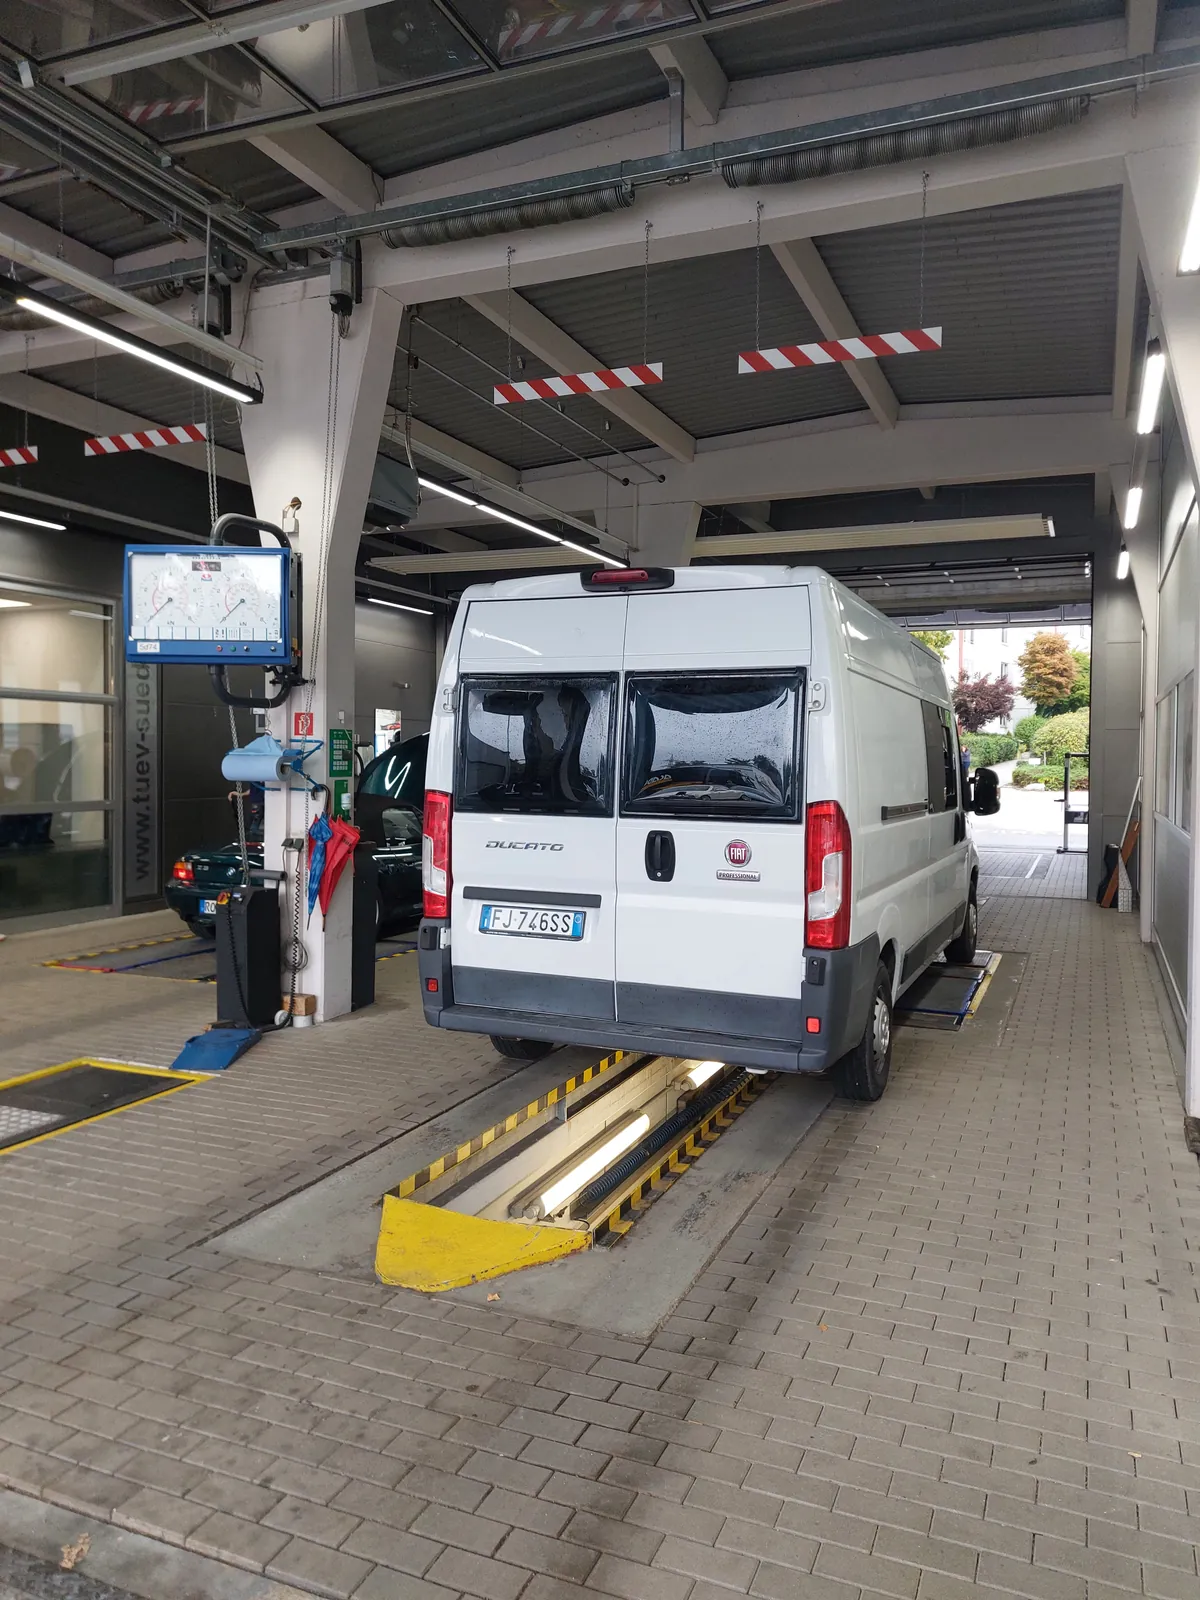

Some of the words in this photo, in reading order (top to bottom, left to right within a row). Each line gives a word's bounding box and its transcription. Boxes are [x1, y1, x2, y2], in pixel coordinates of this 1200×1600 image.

[485, 840, 564, 852] DUCATO
[730, 847, 746, 861] FIAT
[719, 872, 757, 880] PROFESSIONAL
